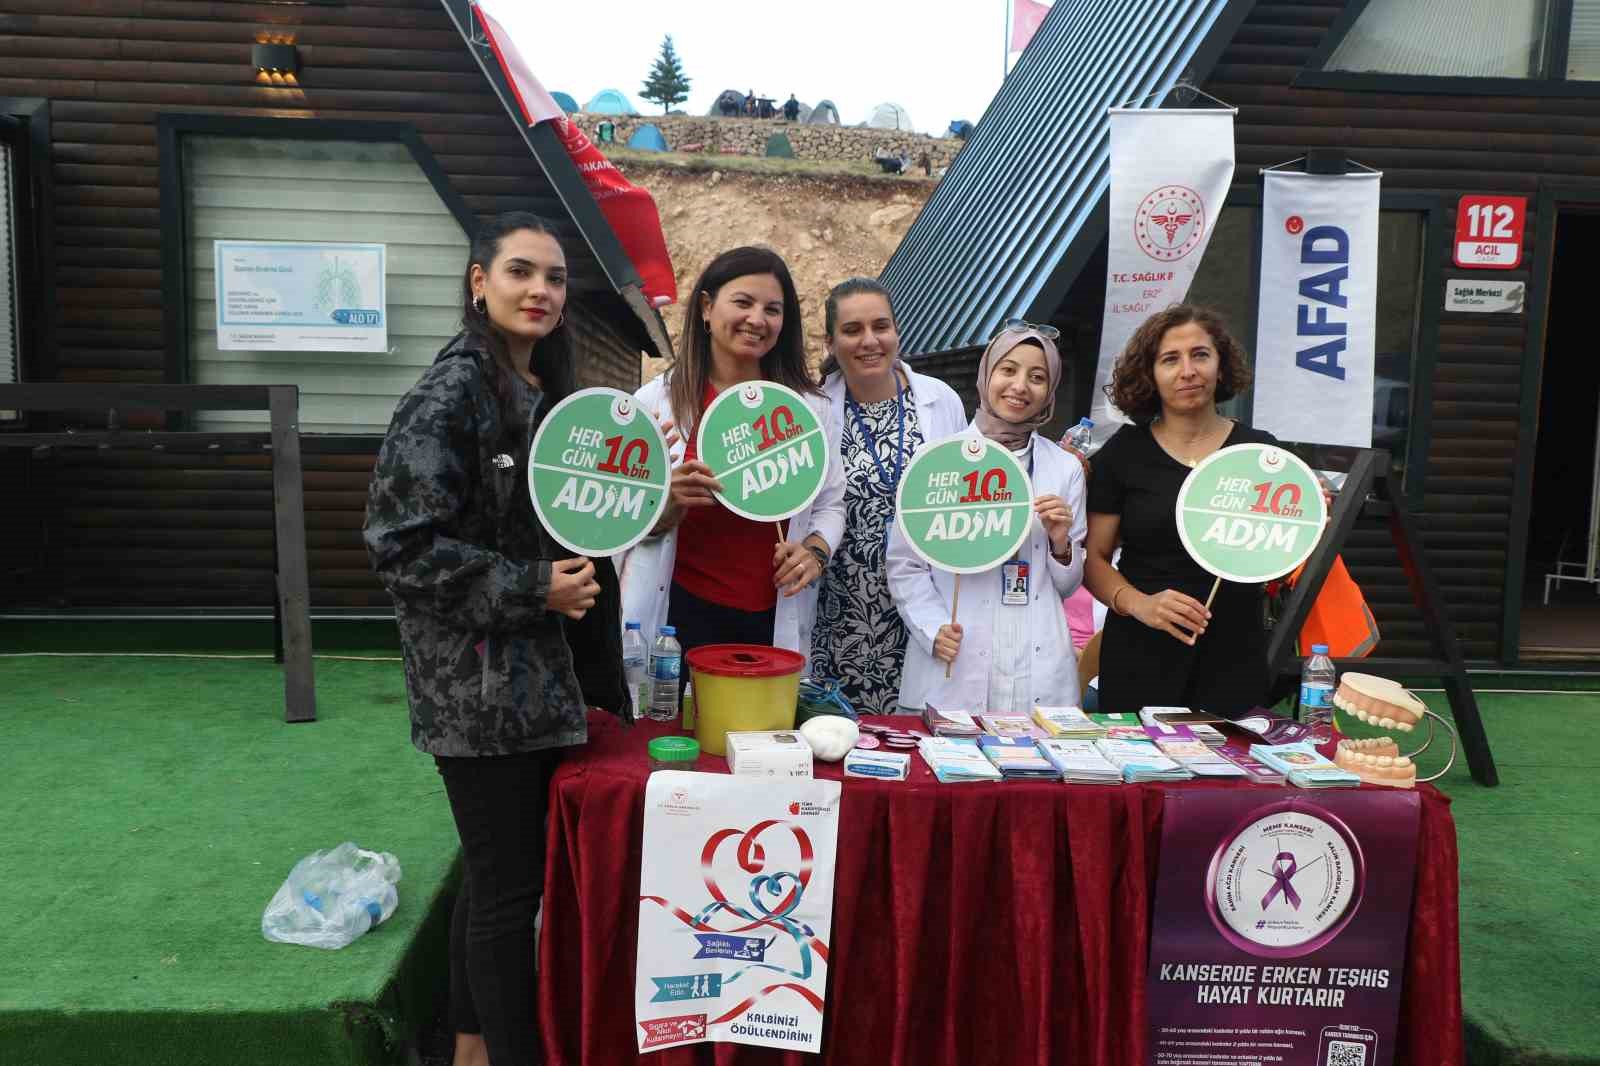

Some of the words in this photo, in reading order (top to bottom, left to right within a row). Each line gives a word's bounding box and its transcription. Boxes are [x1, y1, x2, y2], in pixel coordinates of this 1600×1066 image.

[1467, 204, 1514, 238] 112
[1296, 225, 1349, 380] AFAD
[567, 425, 603, 448] HER
[720, 422, 752, 447] HER
[752, 405, 794, 451] 10
[784, 423, 804, 439] bin
[561, 448, 597, 468] GÜN
[596, 434, 649, 475] 10
[629, 467, 650, 480] bin
[727, 441, 756, 465] GÜN
[927, 471, 960, 488] HER
[959, 467, 1008, 503] 10
[992, 488, 1012, 501] bin
[1216, 476, 1251, 493] HER
[926, 488, 959, 505] GÜN
[1209, 493, 1245, 510] GÜN
[1248, 481, 1302, 515] 10
[1281, 504, 1303, 517] bin
[1160, 964, 1257, 983] KANSERDE
[1261, 966, 1321, 985] ERKEN
[1197, 985, 1253, 1005] HAYAT
[1257, 987, 1345, 1008] KURTARIR
[746, 1012, 799, 1027] KALBİNİZİ
[730, 1023, 813, 1043] ÖDÜLLENDİRİN!
